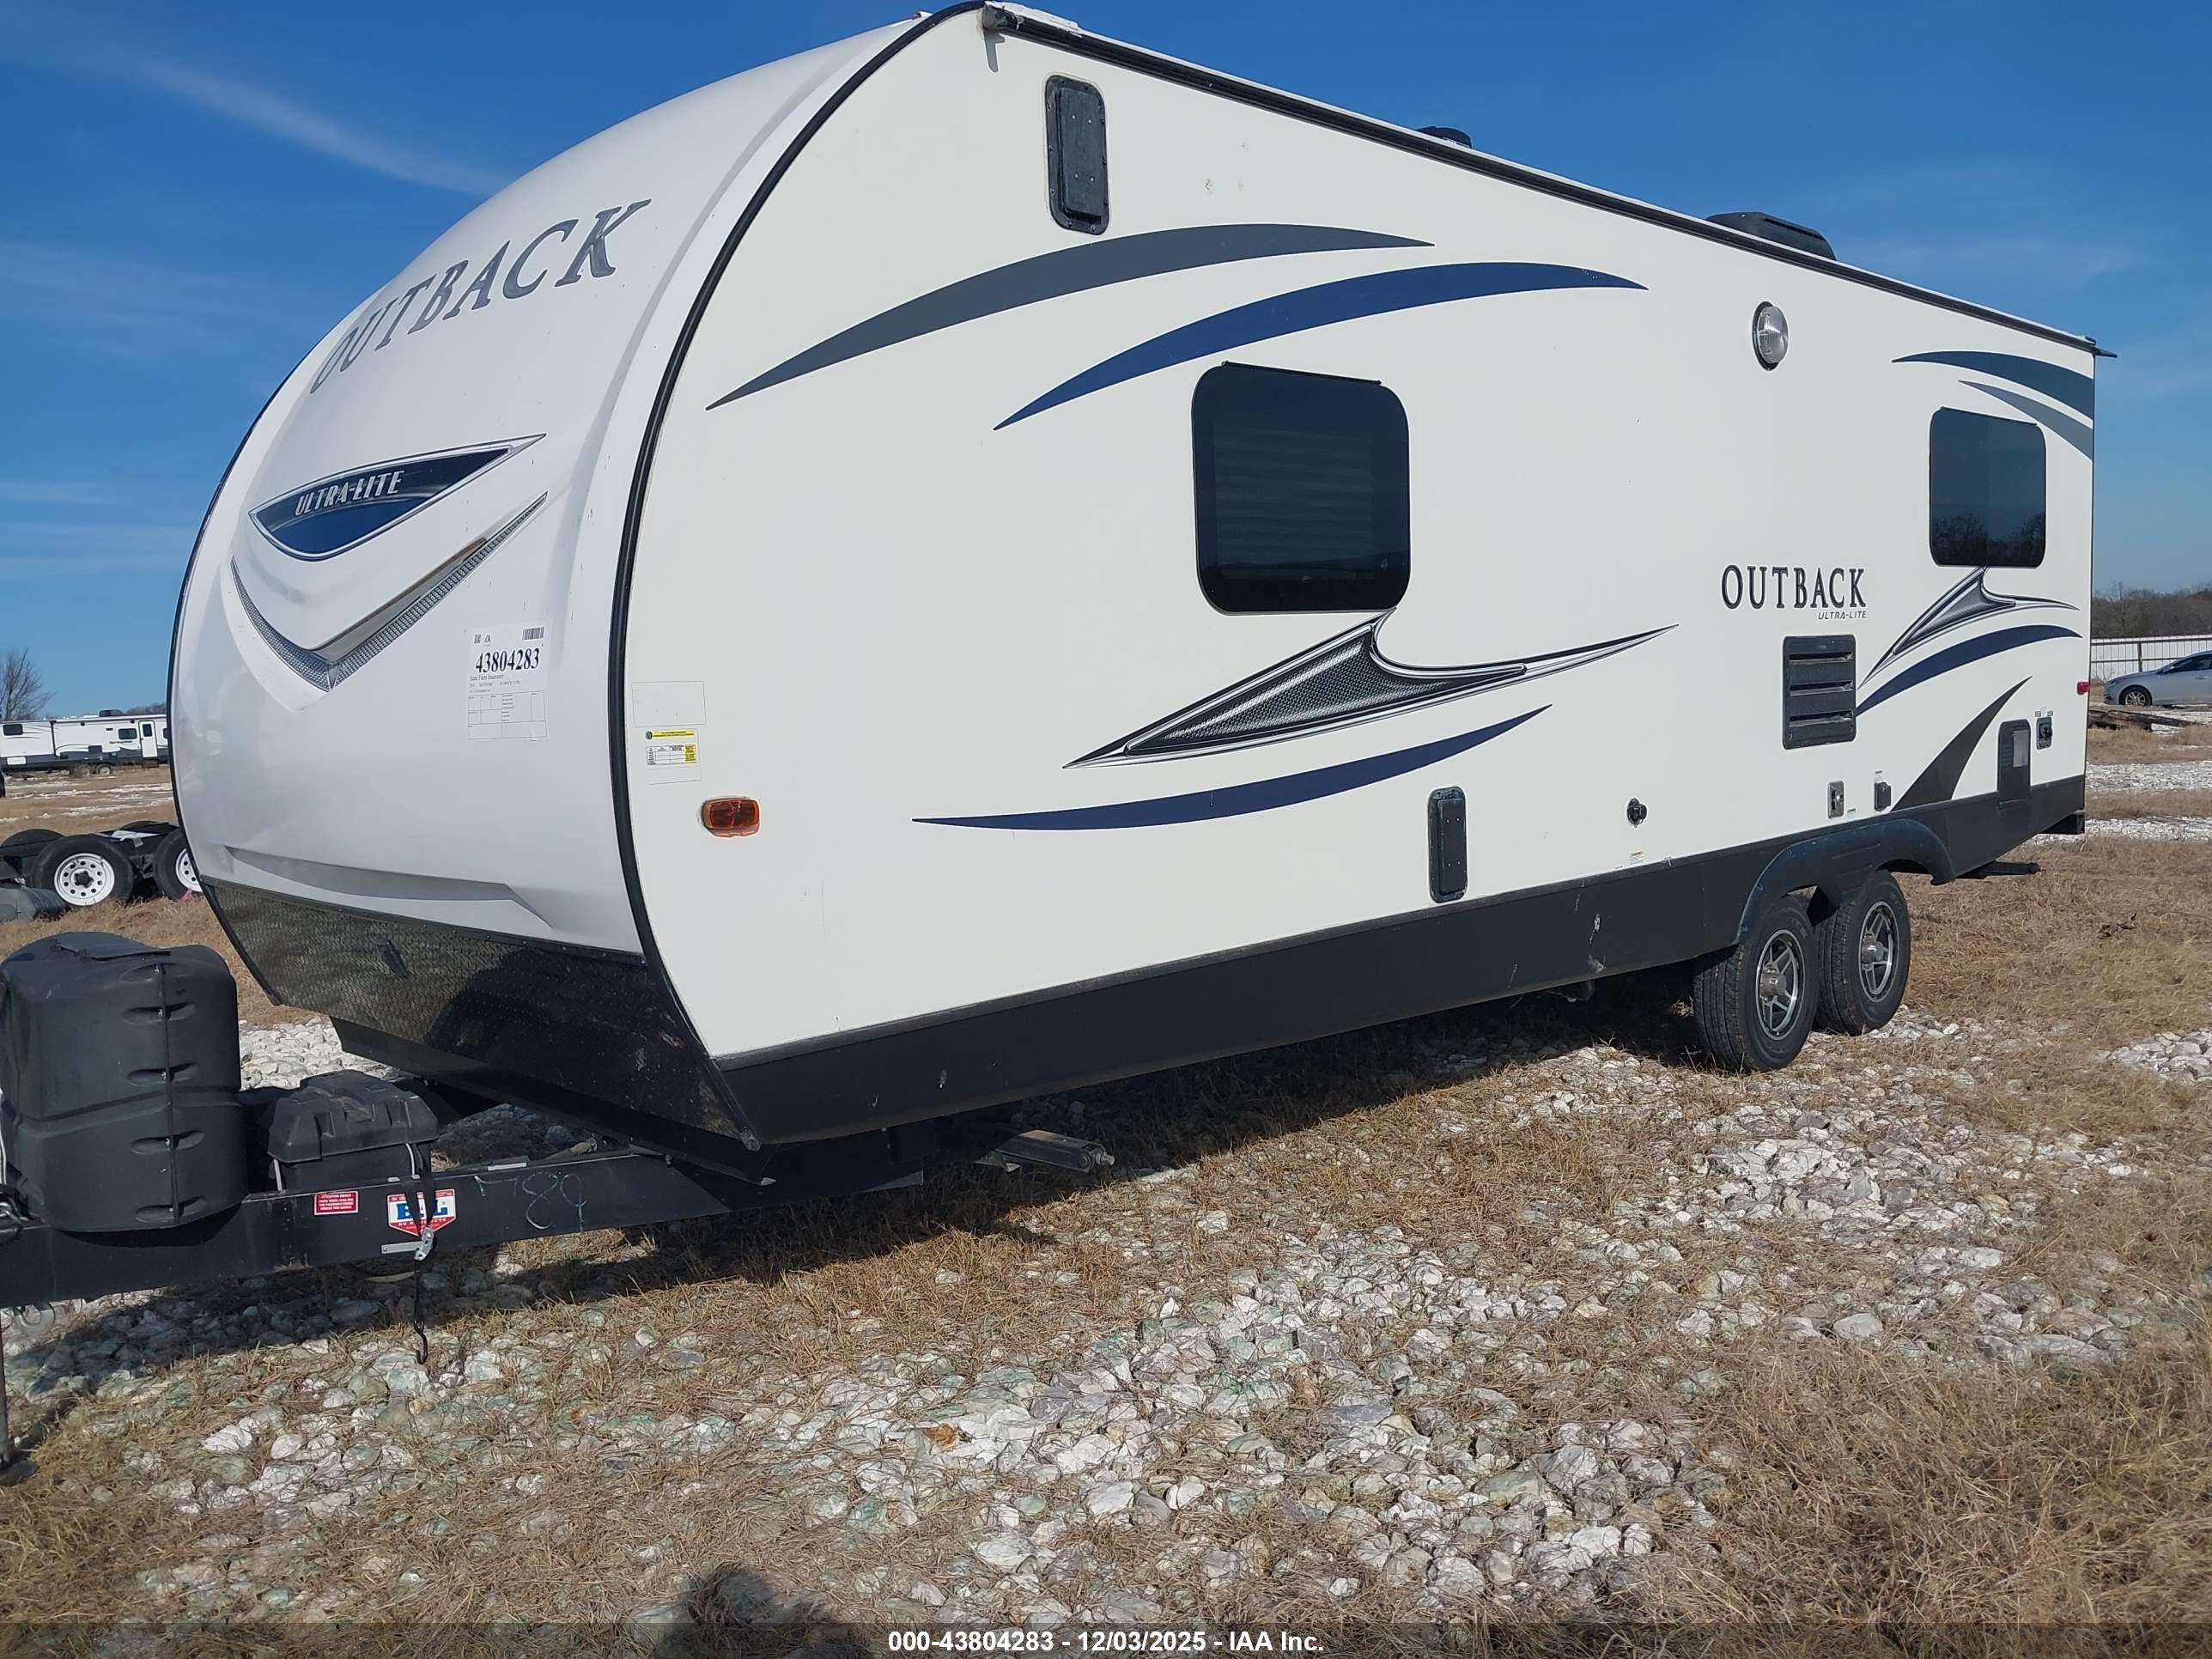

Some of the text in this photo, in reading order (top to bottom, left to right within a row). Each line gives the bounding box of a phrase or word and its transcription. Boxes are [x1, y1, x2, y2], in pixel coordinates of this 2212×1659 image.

[310, 198, 652, 394] OUTBACK
[295, 470, 405, 516] ULTRA-LITE
[1721, 564, 1867, 610] OUTBACK
[1817, 611, 1868, 620] ULTRA-LITE
[475, 647, 540, 673] 43804283
